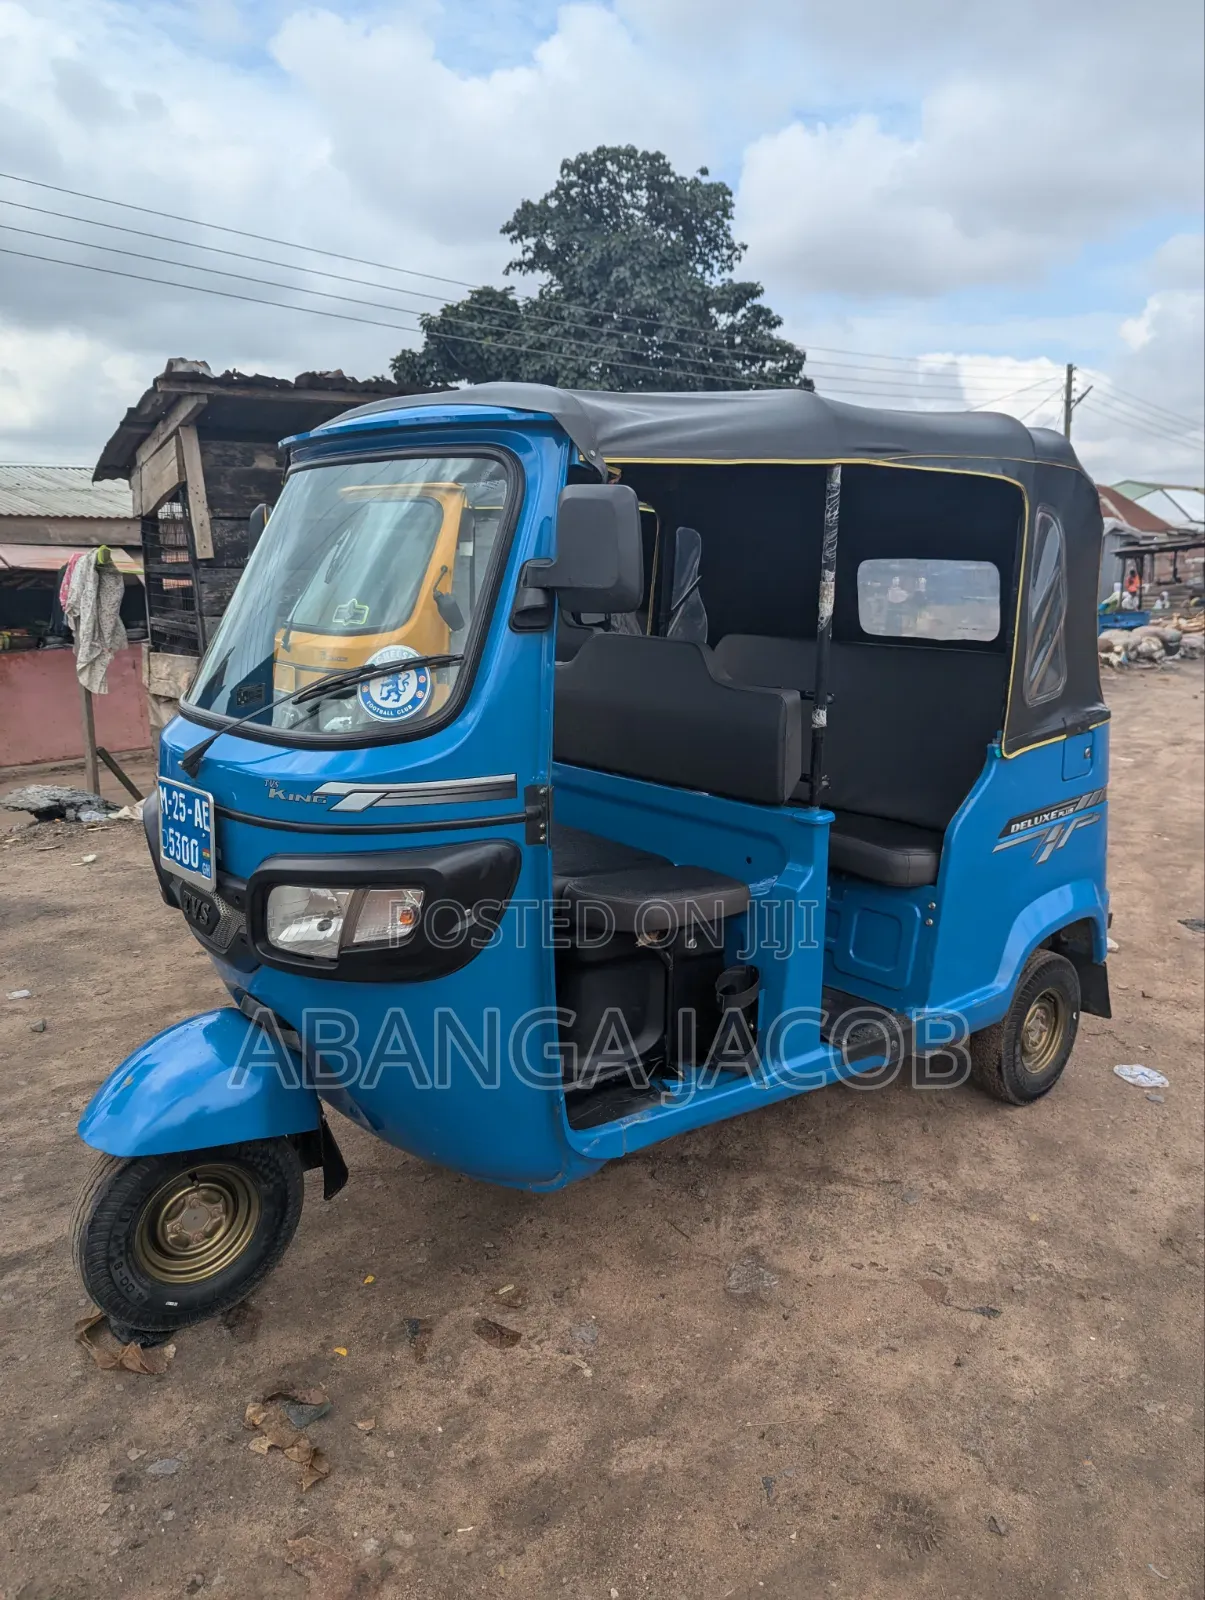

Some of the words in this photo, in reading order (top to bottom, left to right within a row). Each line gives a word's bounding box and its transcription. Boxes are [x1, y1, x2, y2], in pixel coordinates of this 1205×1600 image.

[366, 700, 393, 716] FOOTBALL
[396, 704, 413, 715] CLUB
[264, 780, 280, 788] TVS
[1010, 809, 1059, 833] DELUXE
[1058, 807, 1075, 817] PLUS
[168, 827, 199, 868] 5300
[183, 890, 210, 926] TVS
